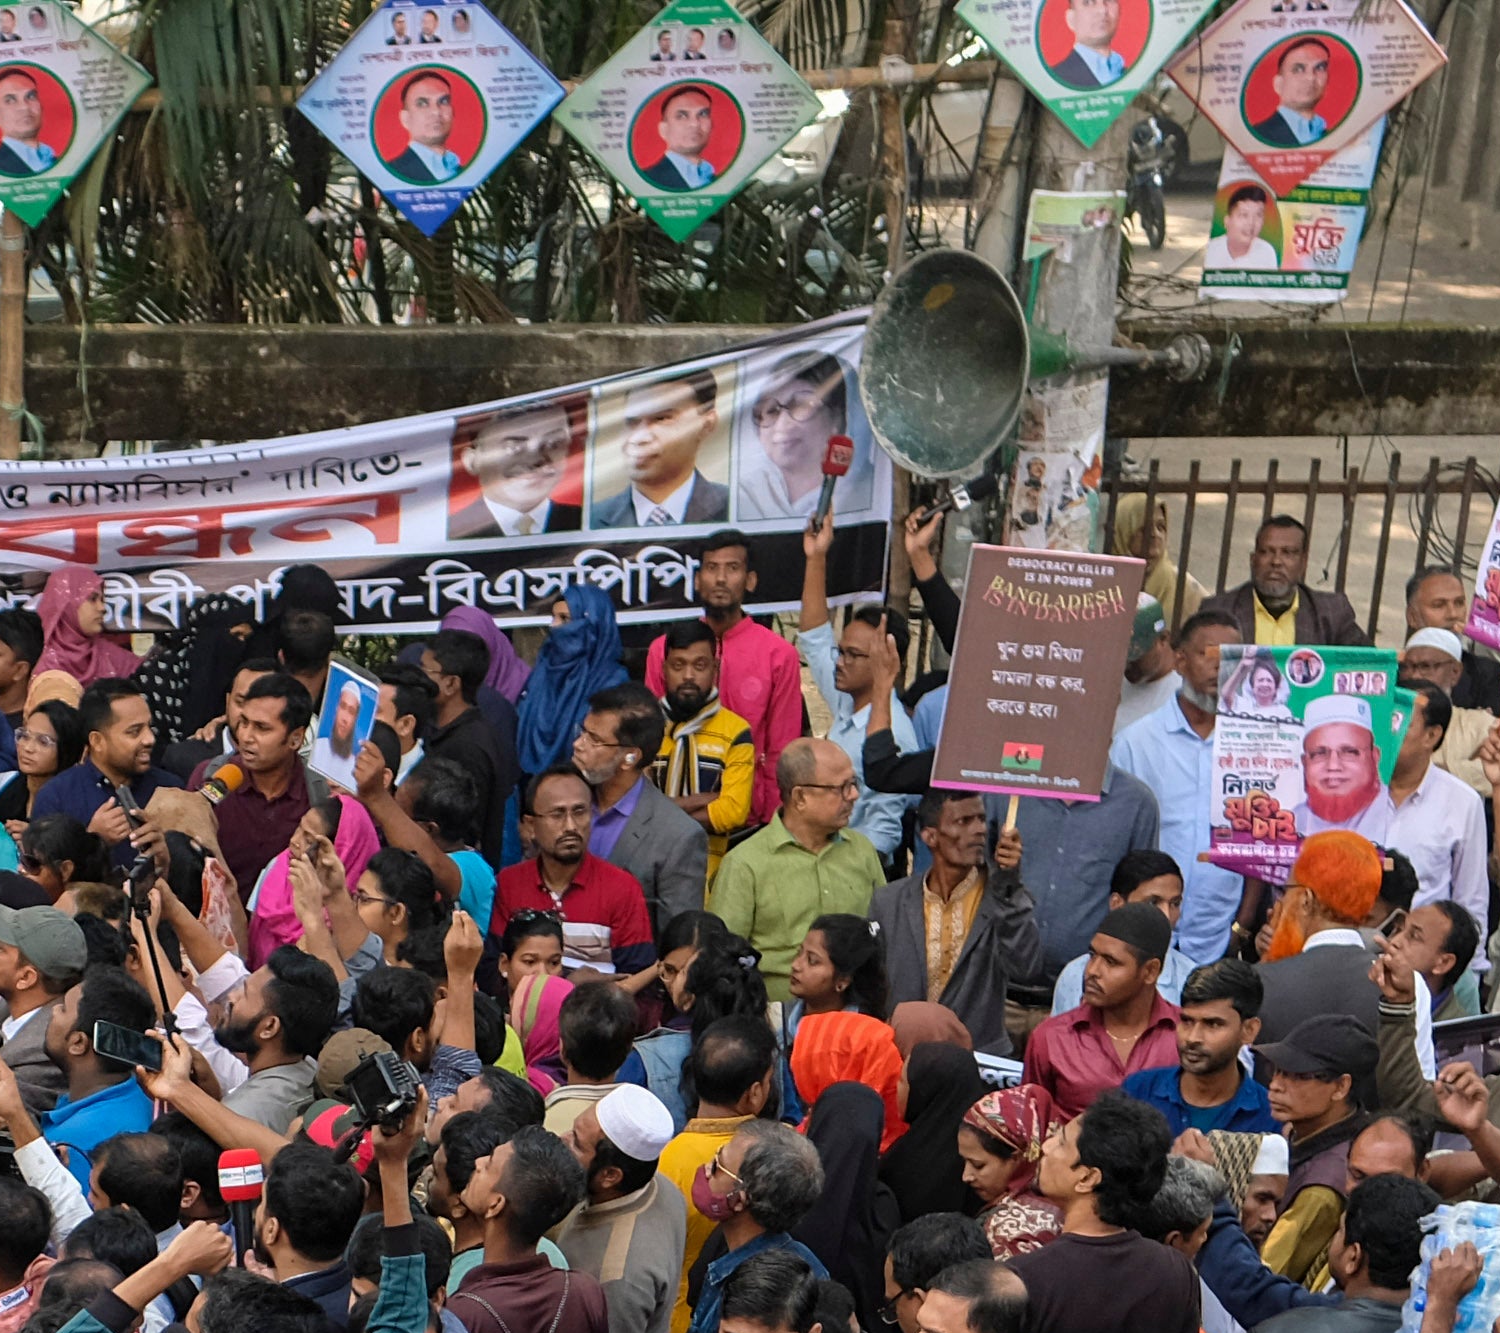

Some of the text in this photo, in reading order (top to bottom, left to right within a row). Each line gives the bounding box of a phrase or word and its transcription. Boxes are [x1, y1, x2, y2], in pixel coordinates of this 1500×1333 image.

[1293, 217, 1345, 258] মুক্তি
[0, 484, 32, 510] ও
[1007, 556, 1115, 577] DEMOCRACY KILLER
[990, 575, 1122, 610] BANGLADESH
[1025, 572, 1093, 588] IS IN POWER
[982, 587, 1127, 623] IS IN DANGER
[998, 640, 1084, 663] খুন গুম মিথ্যা
[992, 669, 1032, 688] মামলা
[1060, 676, 1086, 694] কর,
[986, 698, 1058, 719] করতে হবে।
[1222, 772, 1280, 796] নিঃশর্ত
[1222, 788, 1281, 831] মুক্তি
[1251, 808, 1298, 842] চাই
